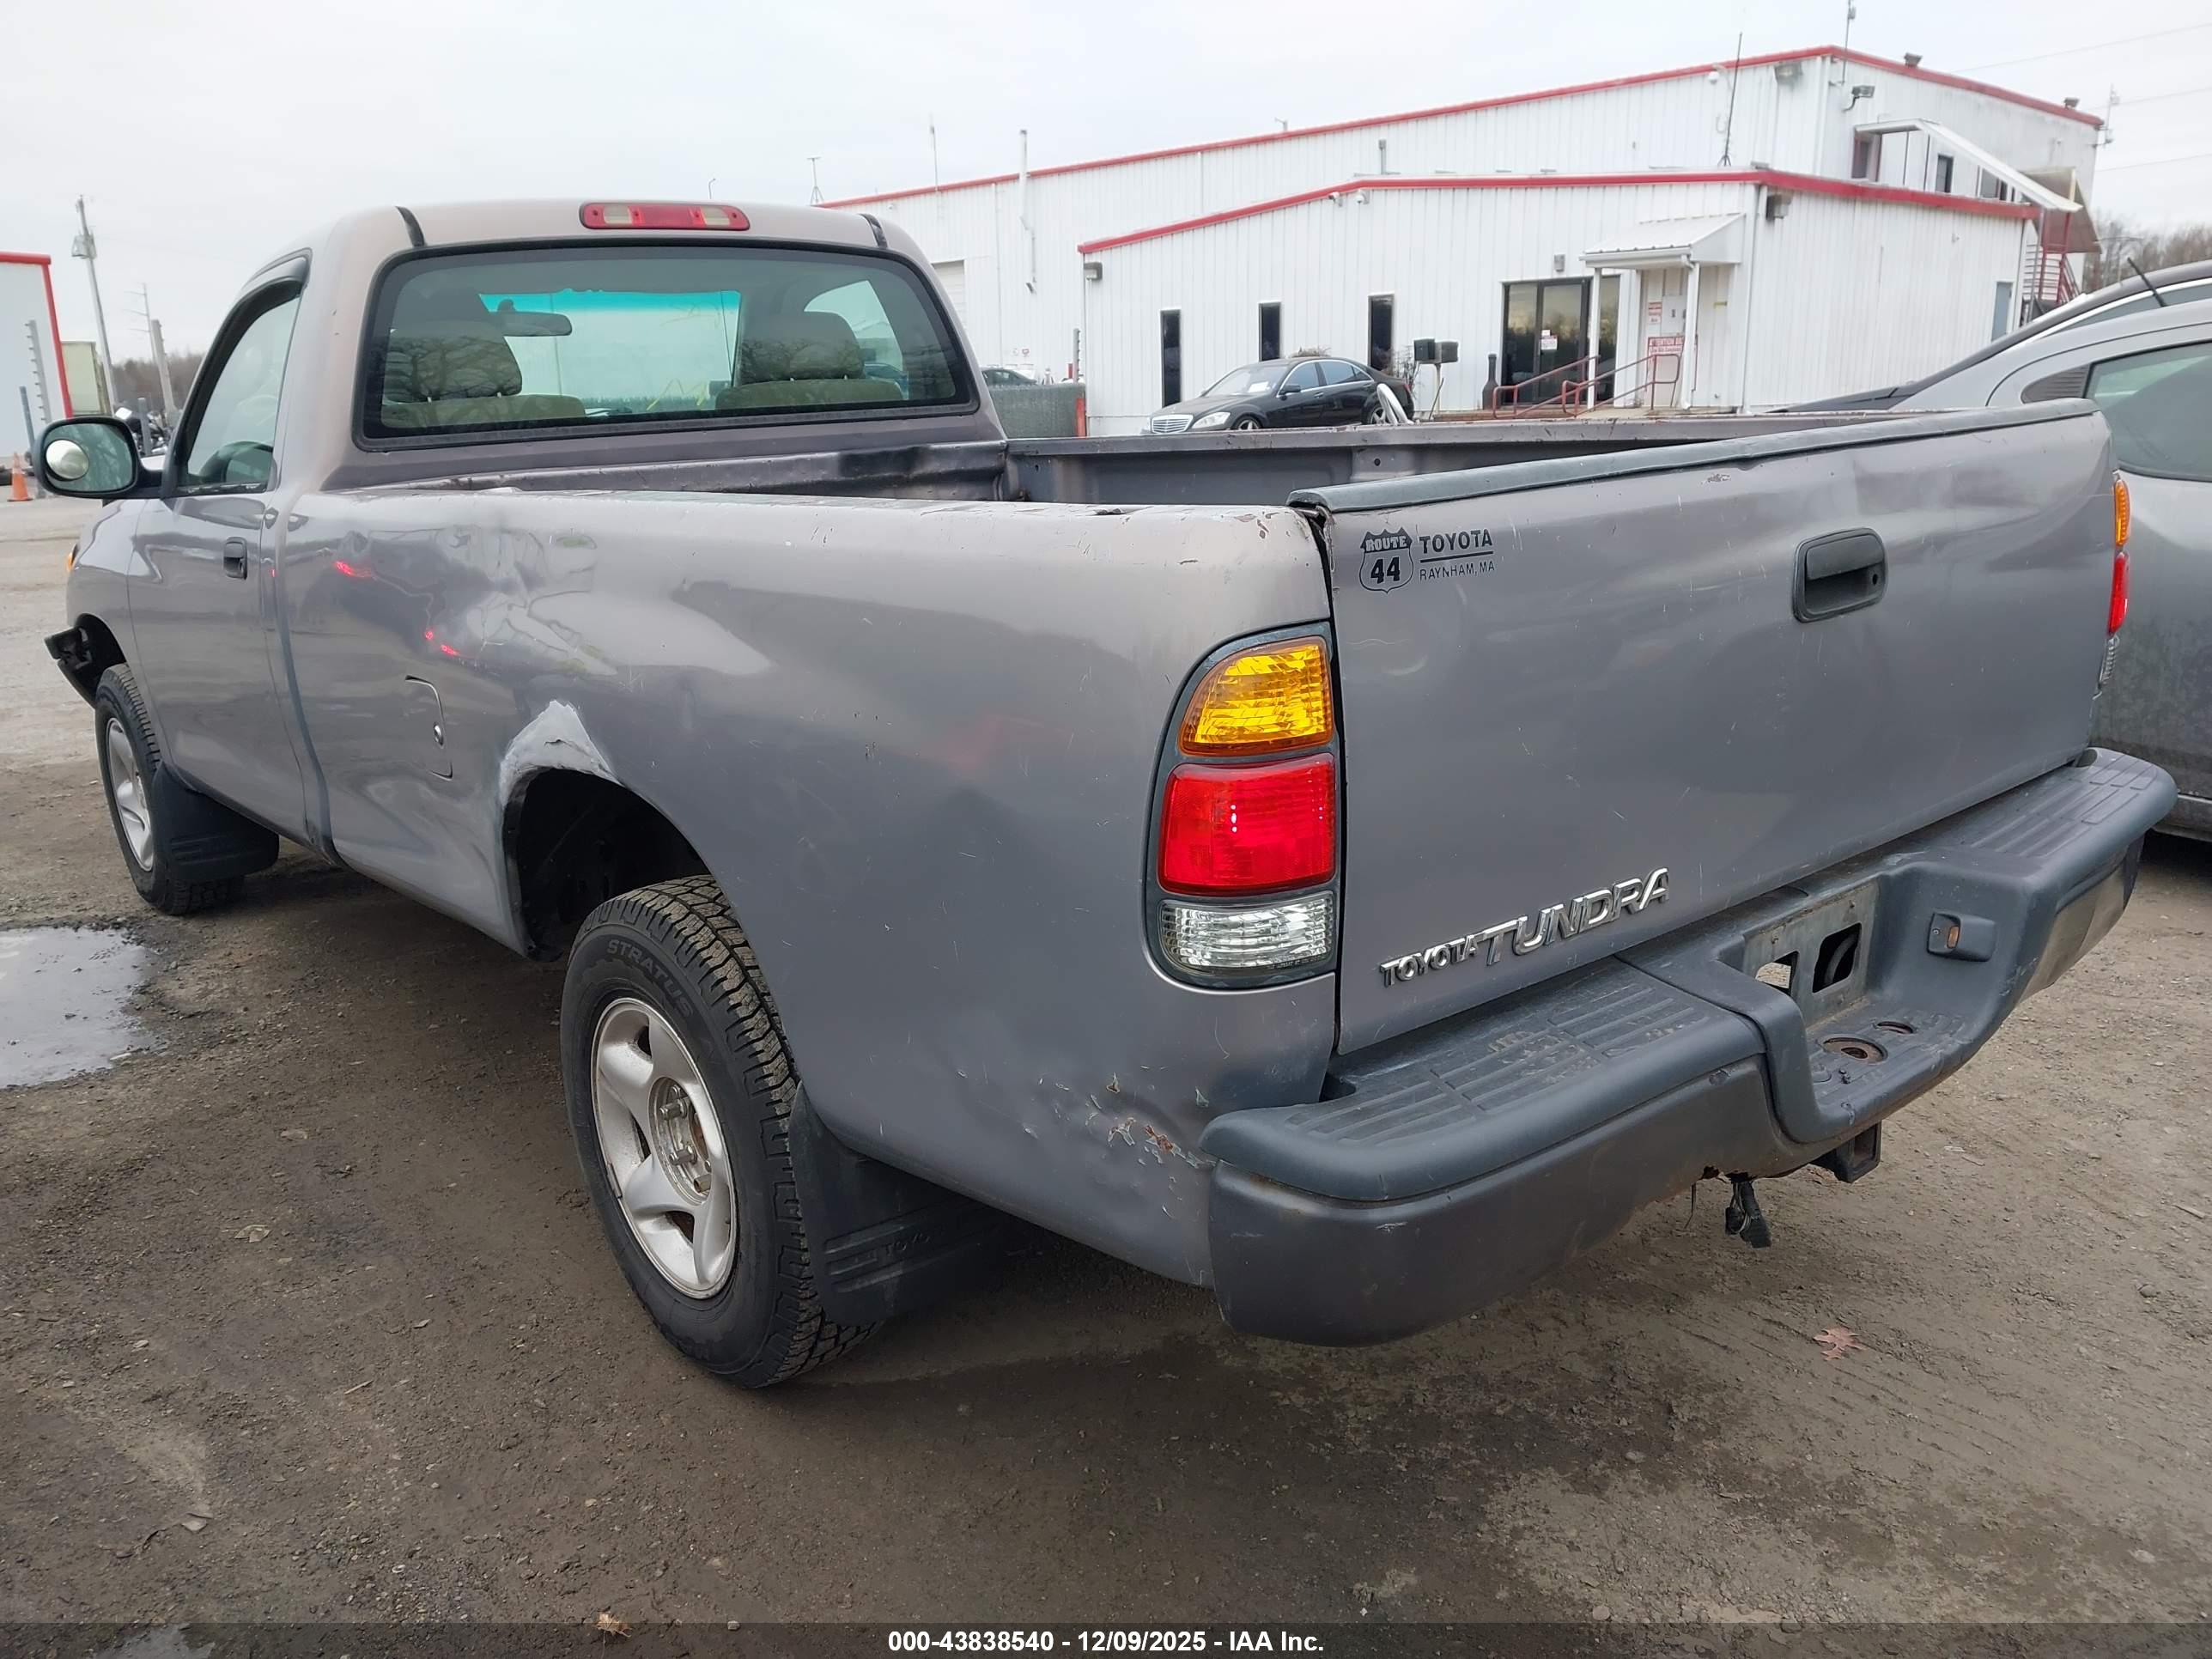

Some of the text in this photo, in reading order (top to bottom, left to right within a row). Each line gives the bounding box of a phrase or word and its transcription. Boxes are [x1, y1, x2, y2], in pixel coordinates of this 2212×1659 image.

[1364, 535, 1407, 552] ROUTE
[1419, 528, 1492, 554] TOYOTA
[1370, 556, 1401, 584] 44
[1419, 561, 1495, 580] RAYNHAM, MA
[1379, 866, 1669, 988] TOYOTA TUNDRA
[606, 939, 694, 1018] STRATUS
